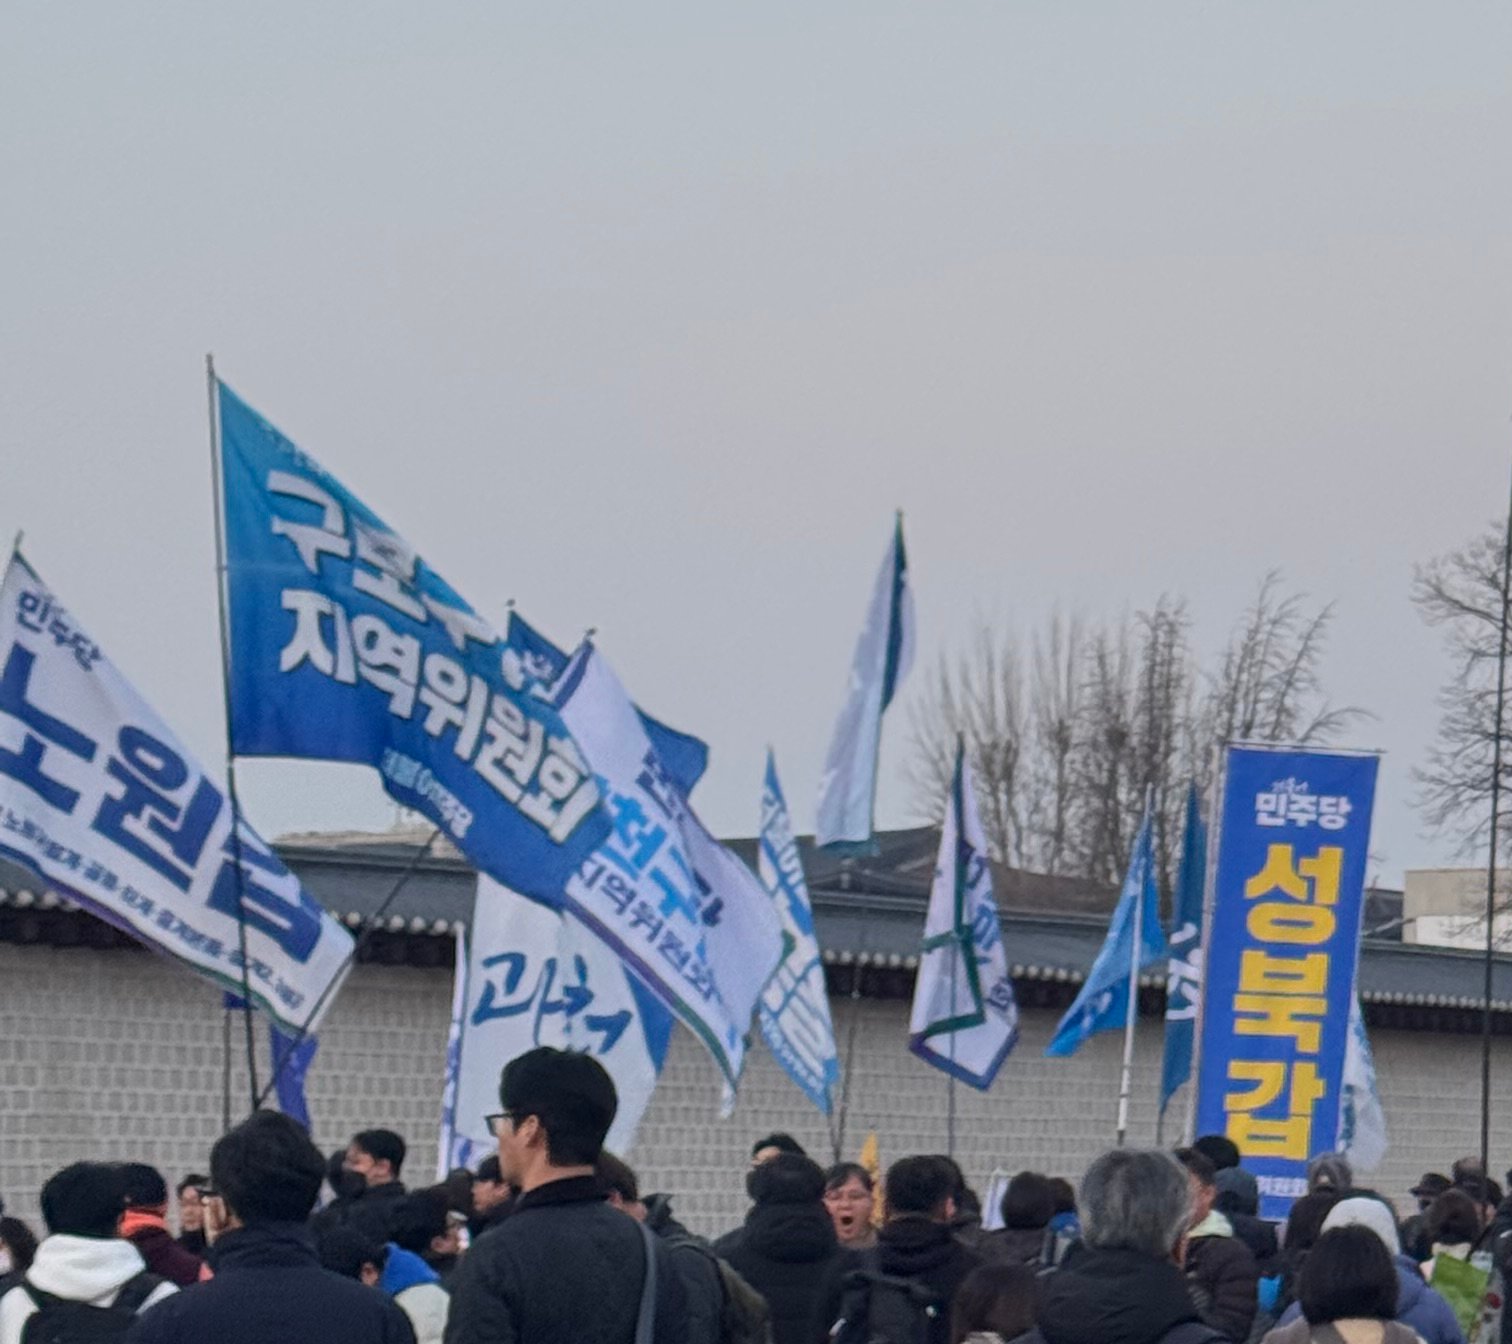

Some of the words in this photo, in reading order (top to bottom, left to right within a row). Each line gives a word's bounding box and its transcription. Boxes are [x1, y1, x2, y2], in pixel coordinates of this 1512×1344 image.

[279, 588, 601, 845] 지역위원회
[1255, 792, 1353, 831] 민주당
[1224, 843, 1344, 1160] 성북갑
